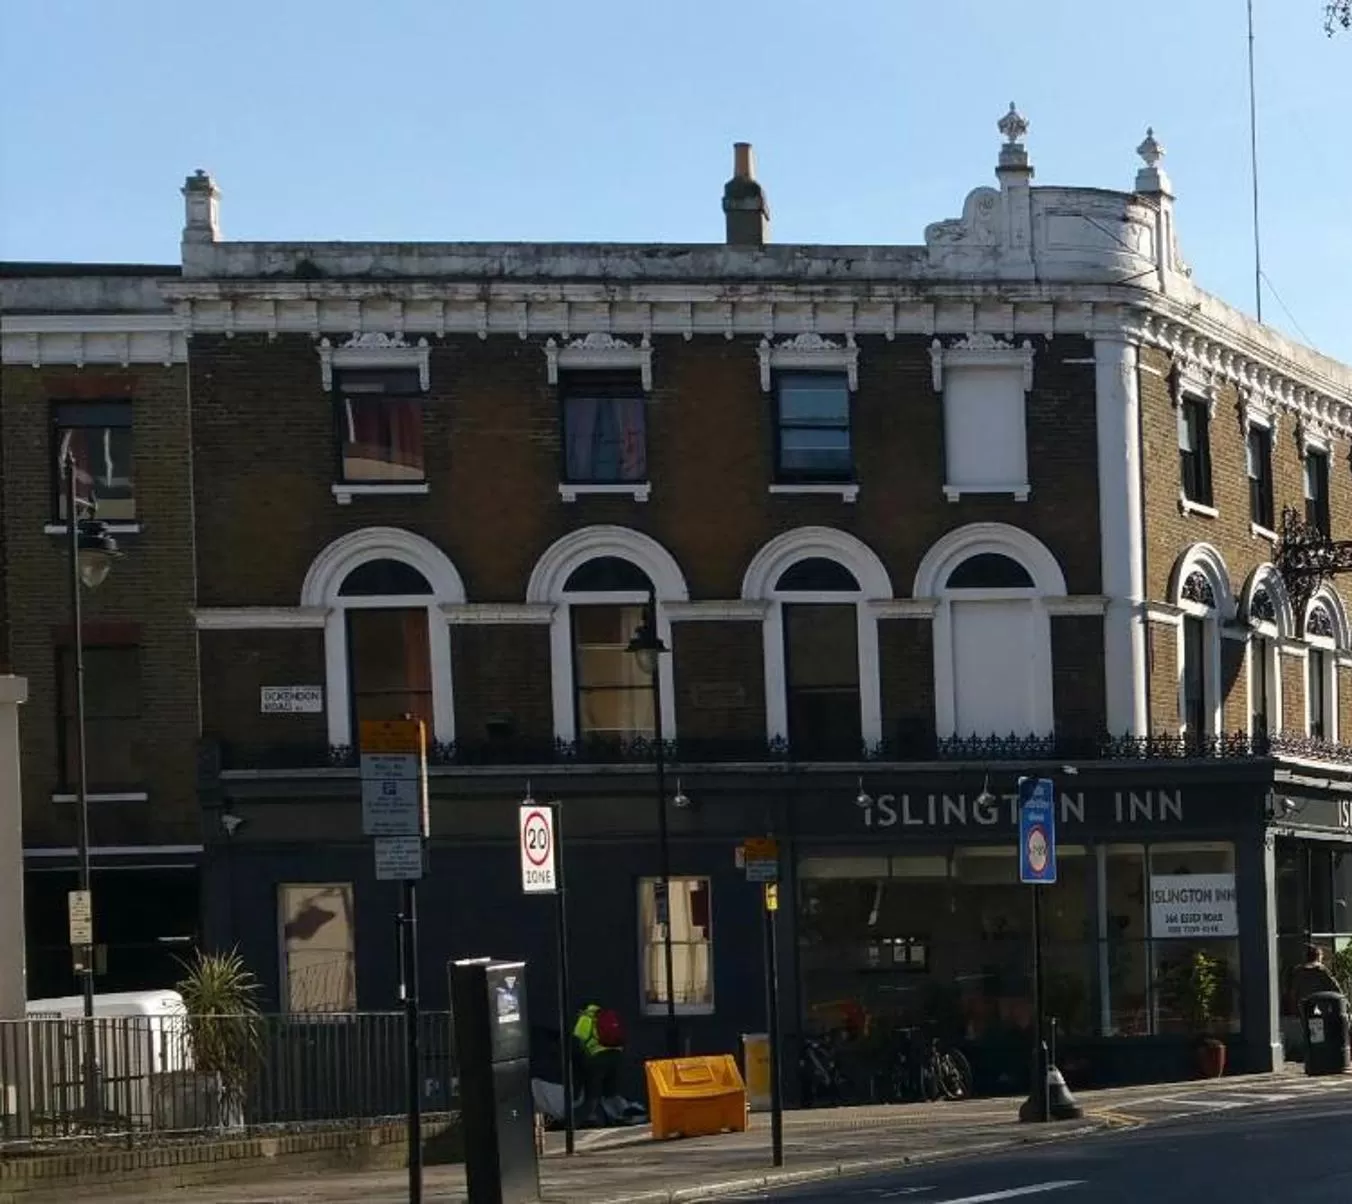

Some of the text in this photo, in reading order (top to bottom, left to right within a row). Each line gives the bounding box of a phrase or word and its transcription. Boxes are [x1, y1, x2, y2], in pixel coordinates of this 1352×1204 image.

[864, 792, 1085, 826] ISLINGTN
[1115, 789, 1183, 823] INN
[528, 828, 547, 850] 20
[526, 870, 551, 884] ZONE
[1151, 887, 1212, 904] ISLINGTON
